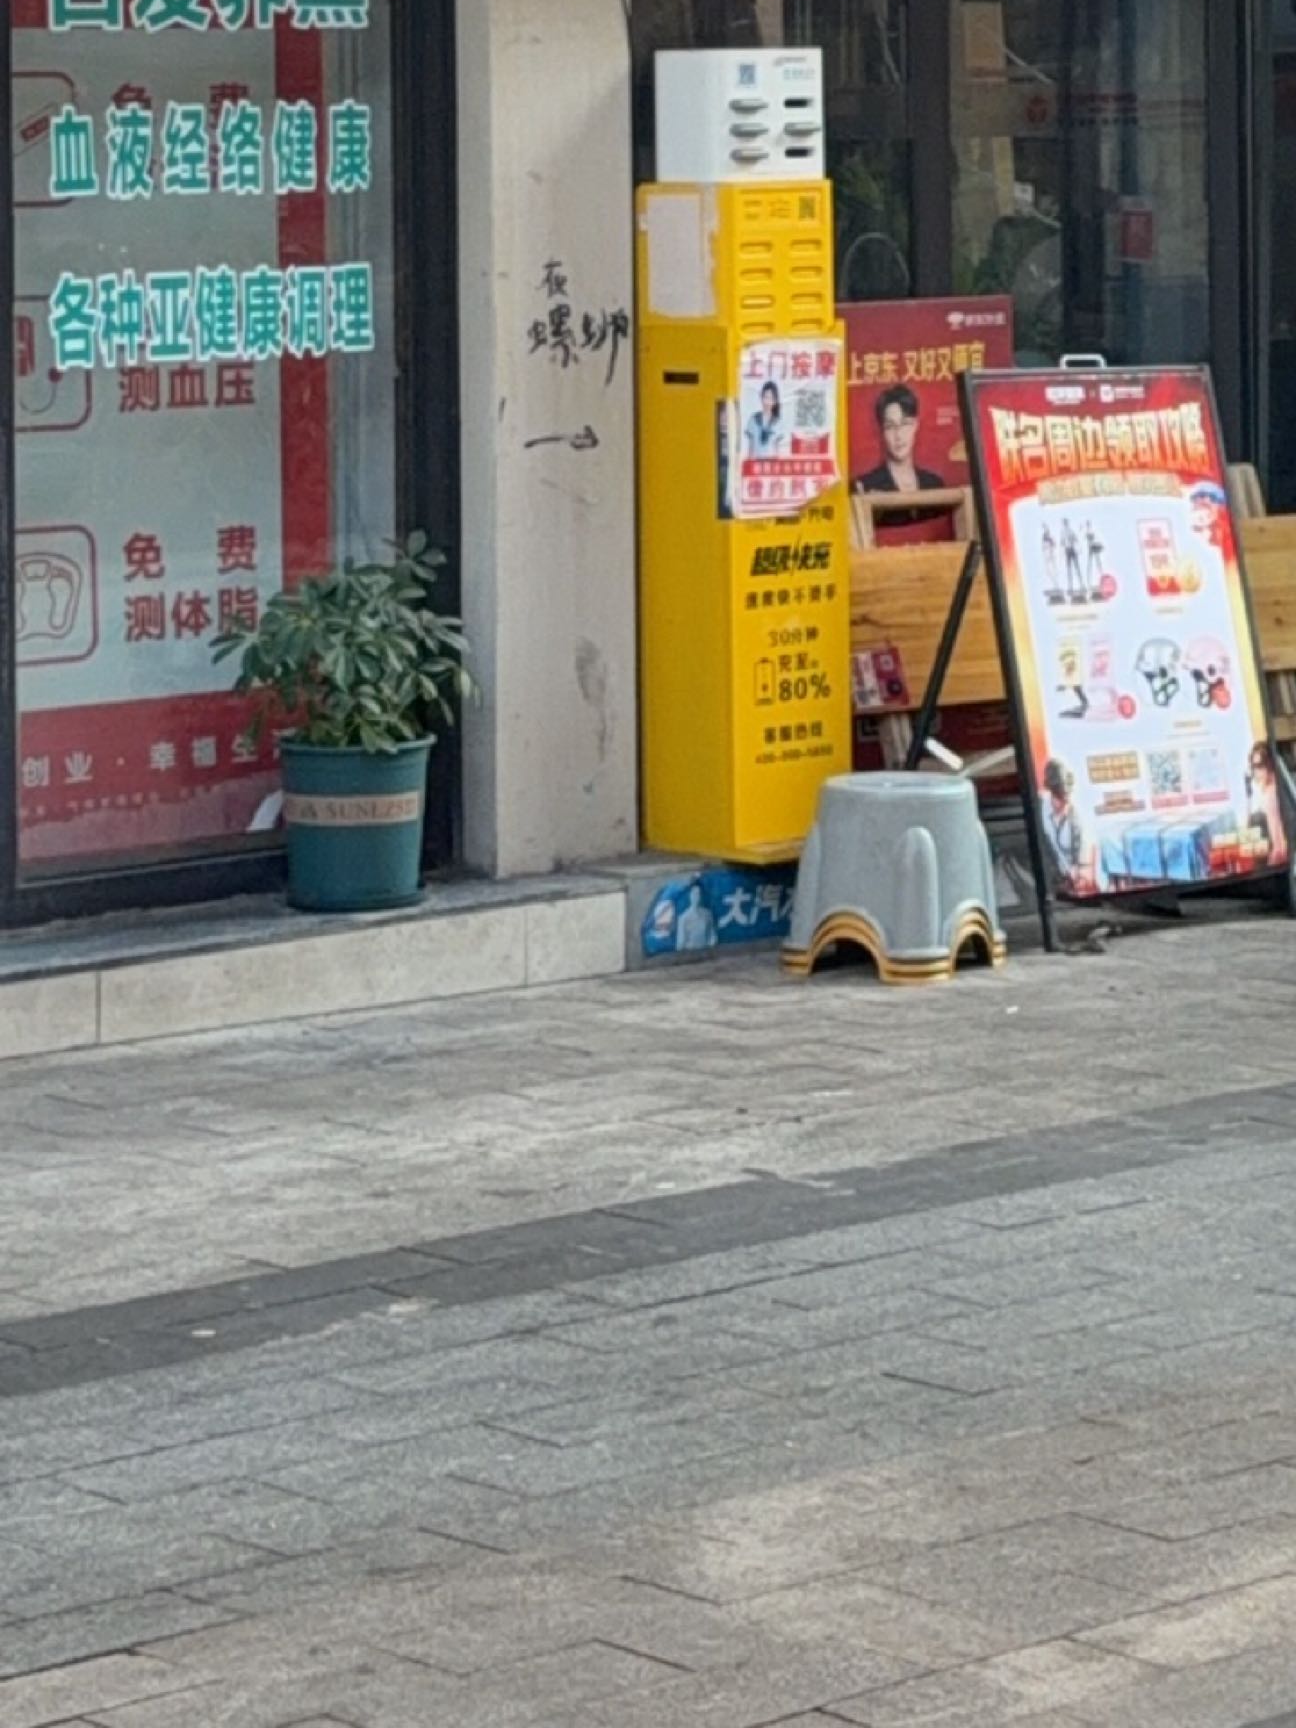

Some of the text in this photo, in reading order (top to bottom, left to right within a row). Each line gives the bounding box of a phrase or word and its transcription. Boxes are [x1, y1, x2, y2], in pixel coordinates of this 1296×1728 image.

[49, 100, 372, 198] 血液经络健康
[49, 261, 375, 370] 各种亚健康调理
[117, 361, 257, 413] 测血压
[743, 349, 836, 381] 上门按摩
[987, 402, 1210, 486] 联名周边领取攻略
[123, 585, 260, 643] 测体脂
[777, 673, 832, 703] 80%
